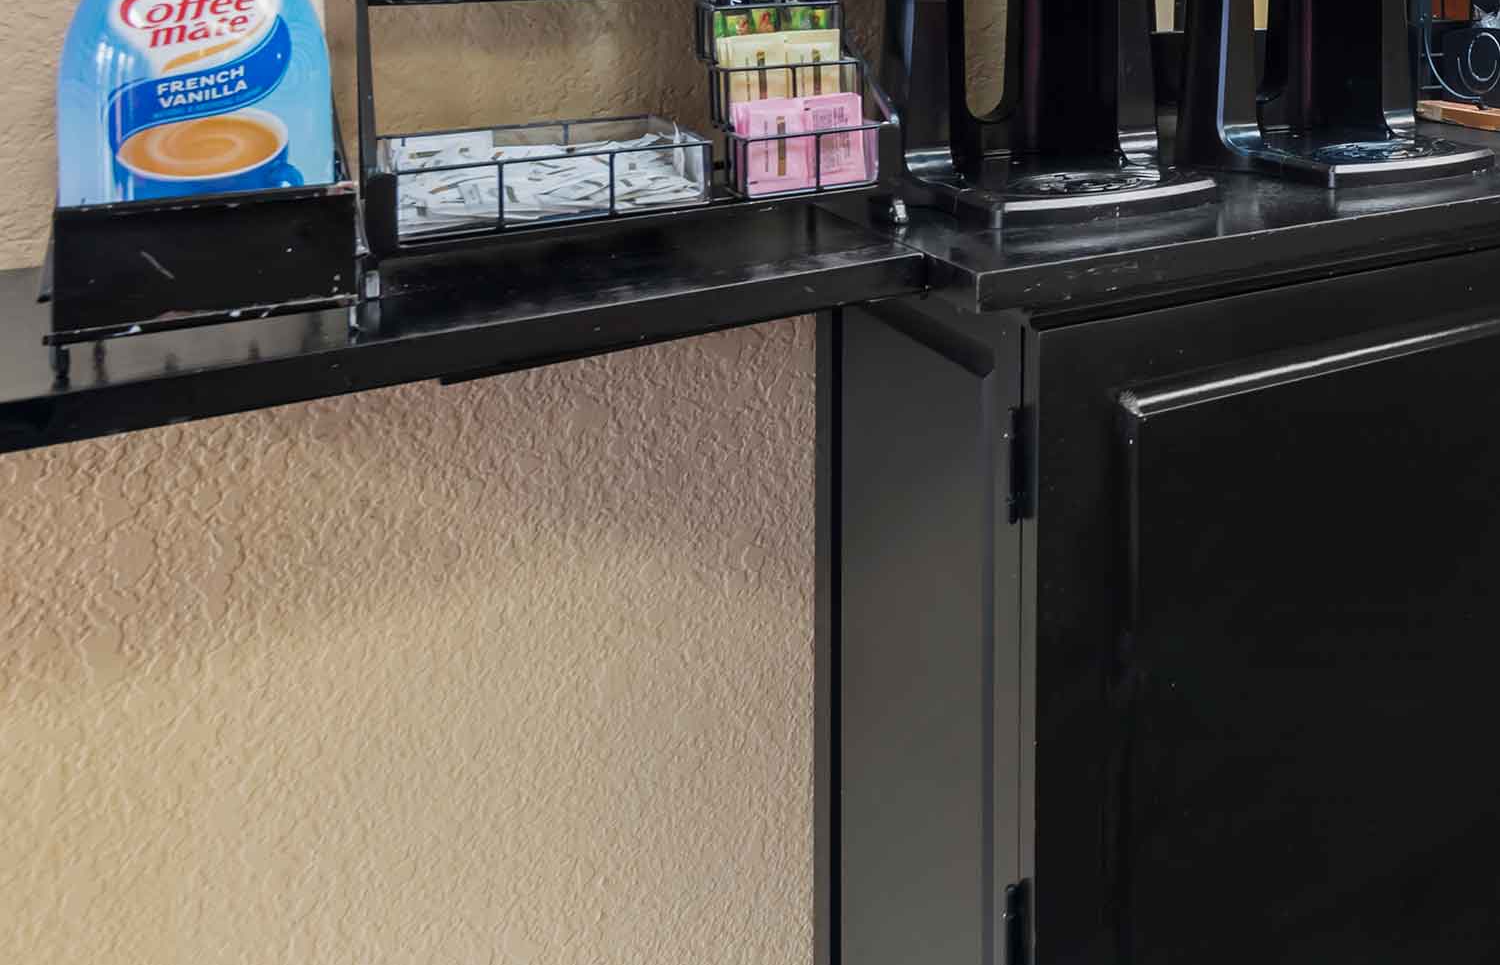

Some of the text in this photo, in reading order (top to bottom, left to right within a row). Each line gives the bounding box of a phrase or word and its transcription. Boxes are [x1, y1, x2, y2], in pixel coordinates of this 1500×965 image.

[149, 15, 250, 48] mate
[157, 65, 245, 96] FRENCH
[159, 79, 249, 109] VANILLA
